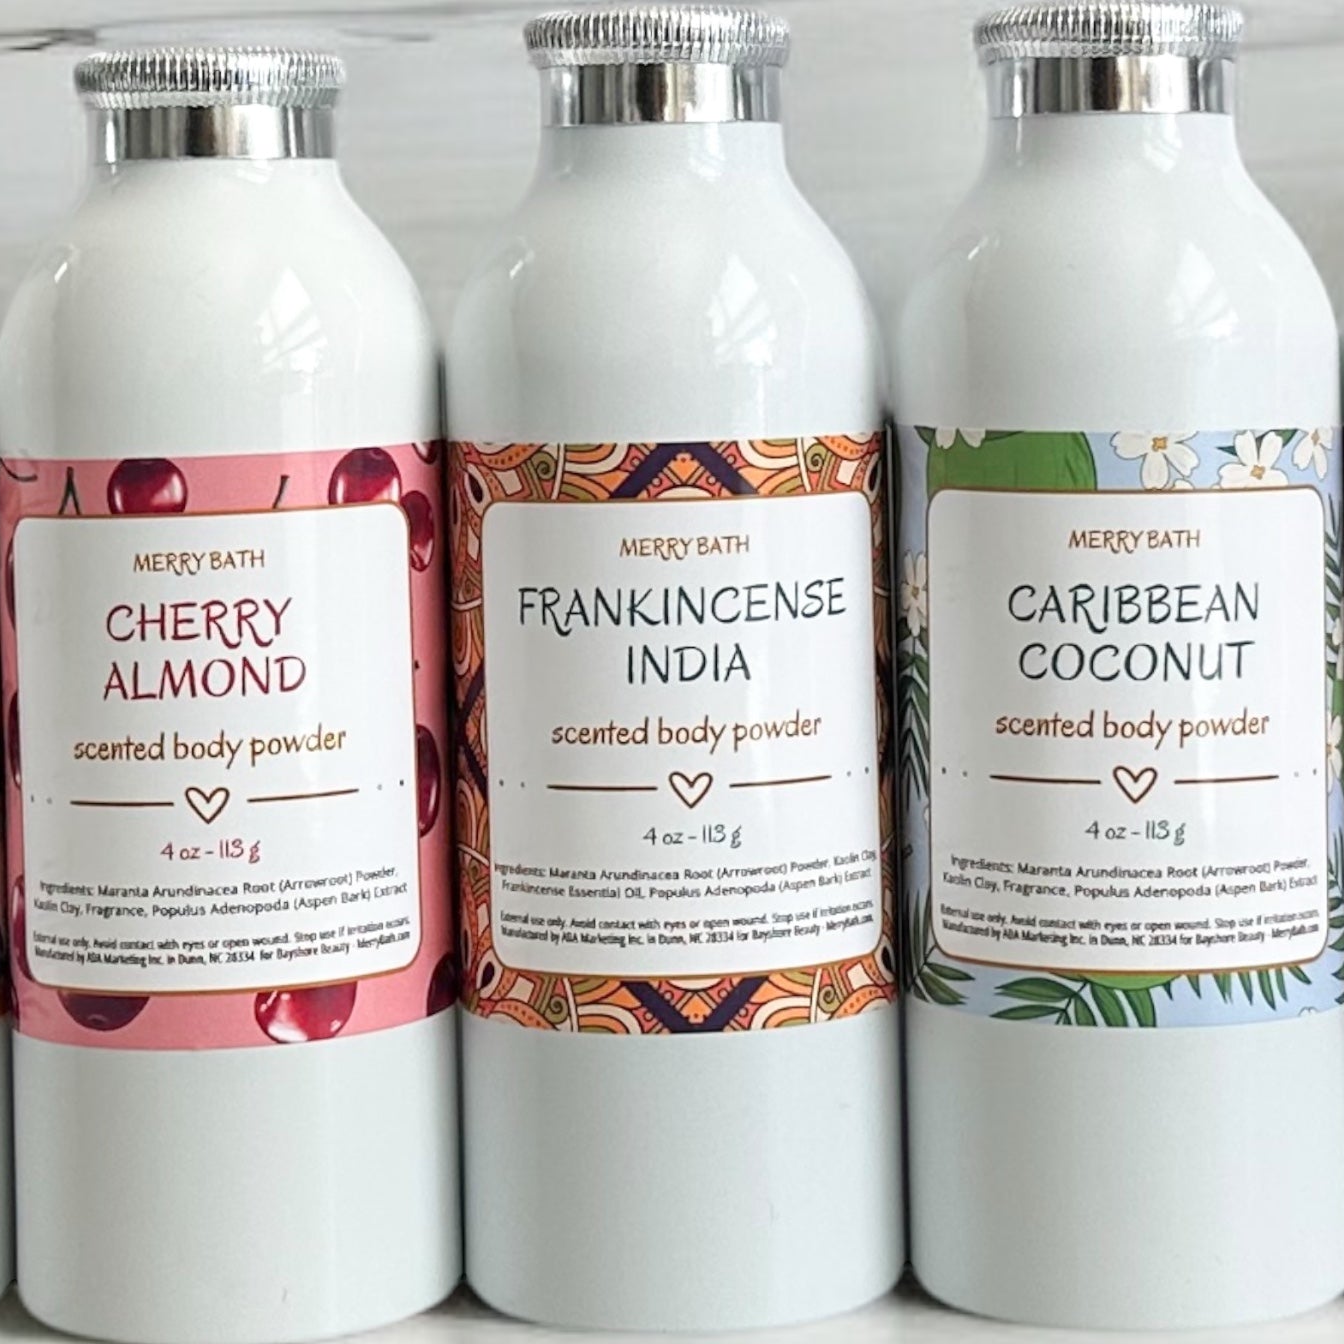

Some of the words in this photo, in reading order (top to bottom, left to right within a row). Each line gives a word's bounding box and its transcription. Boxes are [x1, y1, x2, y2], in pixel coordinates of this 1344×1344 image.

[620, 537, 693, 561] MERRY
[696, 535, 749, 555] BATH
[1069, 530, 1144, 554] MERRY
[1147, 530, 1200, 549] BATH
[133, 552, 206, 576] MERRY
[209, 550, 264, 570] BATH
[107, 598, 292, 649] CHERRY
[519, 577, 846, 637] FRANKINCENSE
[1009, 582, 1258, 634] CARIBBEAN
[104, 656, 306, 700] ALMOND
[628, 643, 751, 684] INDIA
[1019, 641, 1255, 682] COCONUT
[74, 732, 165, 761] scented
[174, 730, 243, 769] body
[249, 723, 346, 766] powder
[552, 717, 649, 745] scented
[658, 715, 726, 755] body
[732, 709, 821, 752] powder
[996, 710, 1094, 738] scented
[1104, 710, 1172, 750] body
[1179, 708, 1269, 748] powder
[161, 843, 174, 860] 4
[180, 847, 200, 860] oz
[220, 840, 244, 858] 113
[248, 840, 260, 864] g
[643, 827, 657, 845] 4
[662, 832, 683, 845] oz
[703, 825, 726, 843] 113
[730, 825, 742, 849] g
[1085, 821, 1100, 839] 4
[1105, 827, 1127, 840] oz
[1146, 820, 1170, 840] 113
[1173, 823, 1186, 846] g
